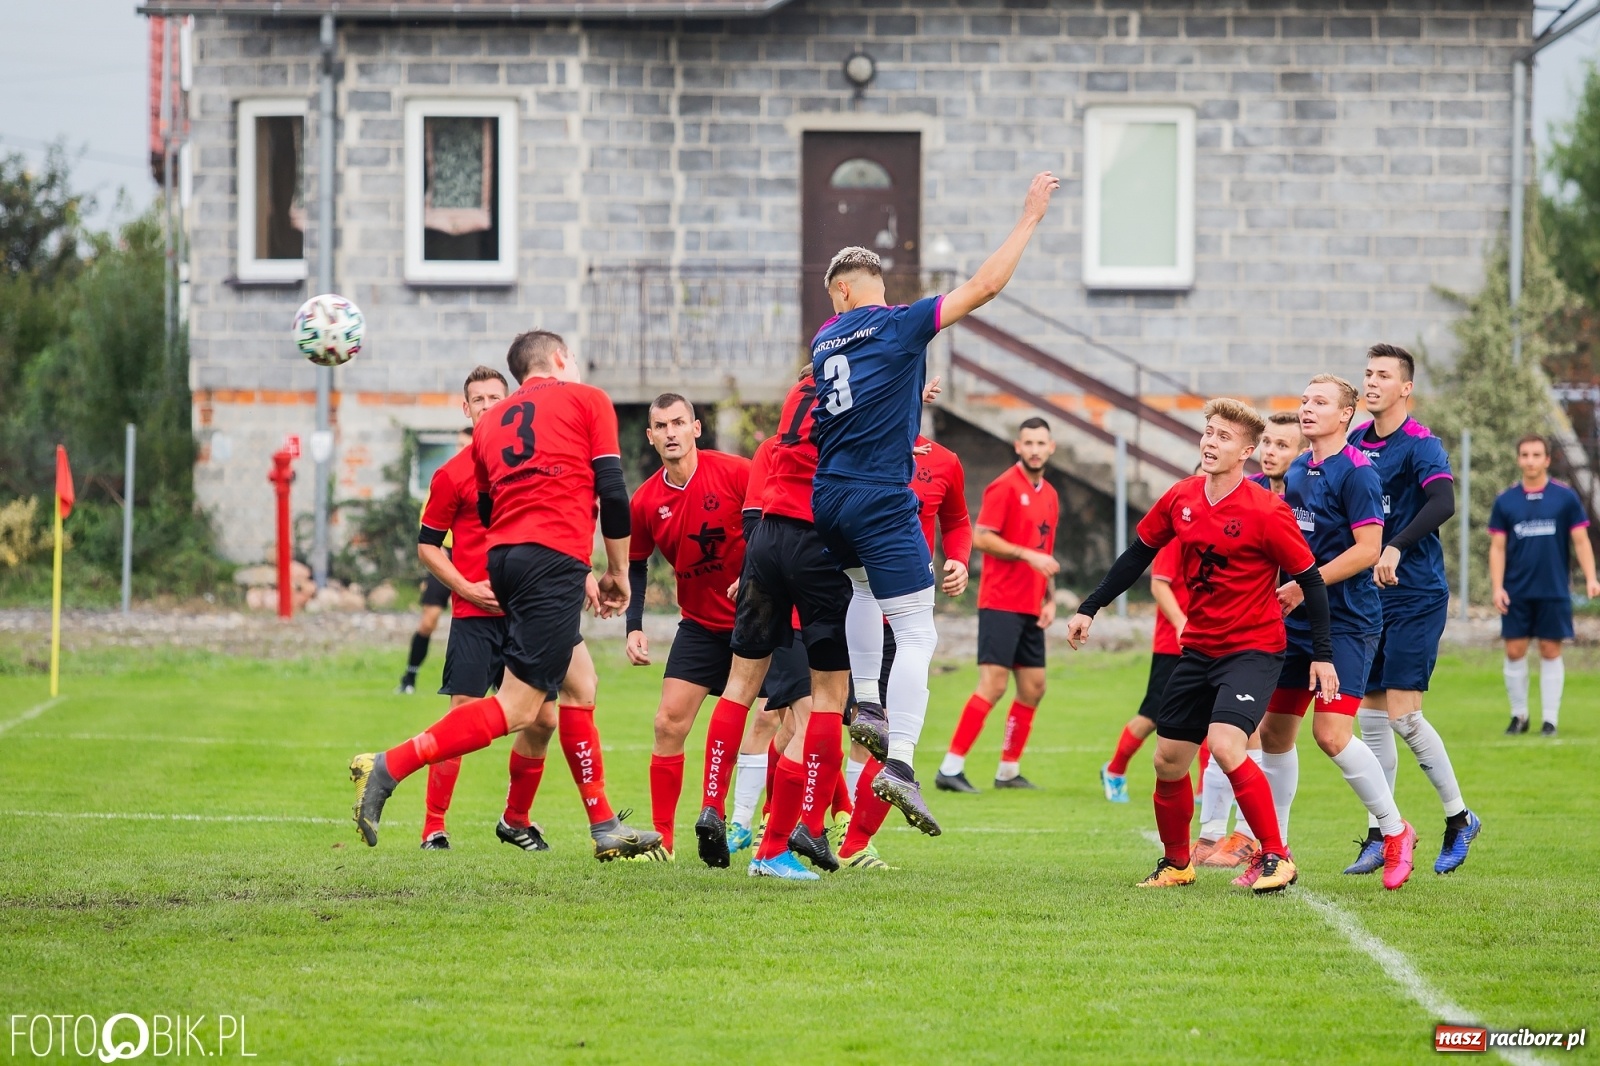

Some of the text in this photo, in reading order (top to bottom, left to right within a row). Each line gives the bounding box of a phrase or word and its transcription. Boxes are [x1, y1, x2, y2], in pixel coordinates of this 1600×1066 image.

[823, 354, 854, 416] 3
[500, 401, 536, 468] 3
[575, 740, 598, 807] TWORKW
[706, 739, 725, 797] TWORKÓW
[802, 753, 821, 812] TWORKÓW
